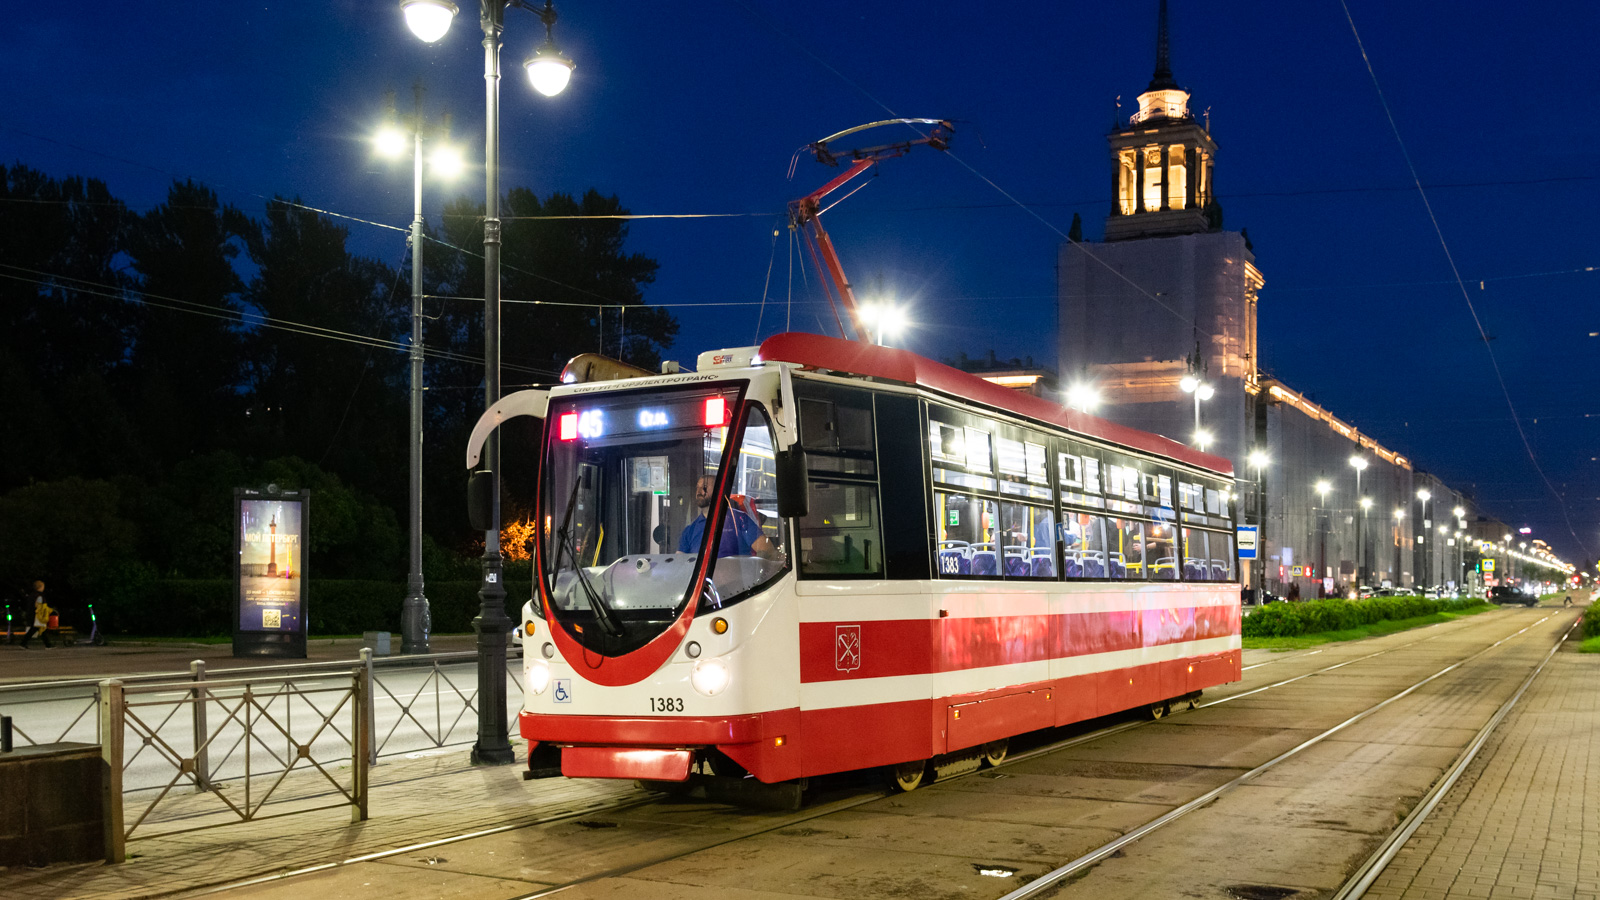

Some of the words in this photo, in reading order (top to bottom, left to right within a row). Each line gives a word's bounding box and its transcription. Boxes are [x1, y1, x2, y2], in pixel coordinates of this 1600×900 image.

[578, 409, 603, 438] 45
[941, 556, 959, 573] 1383
[650, 697, 684, 712] 1383
